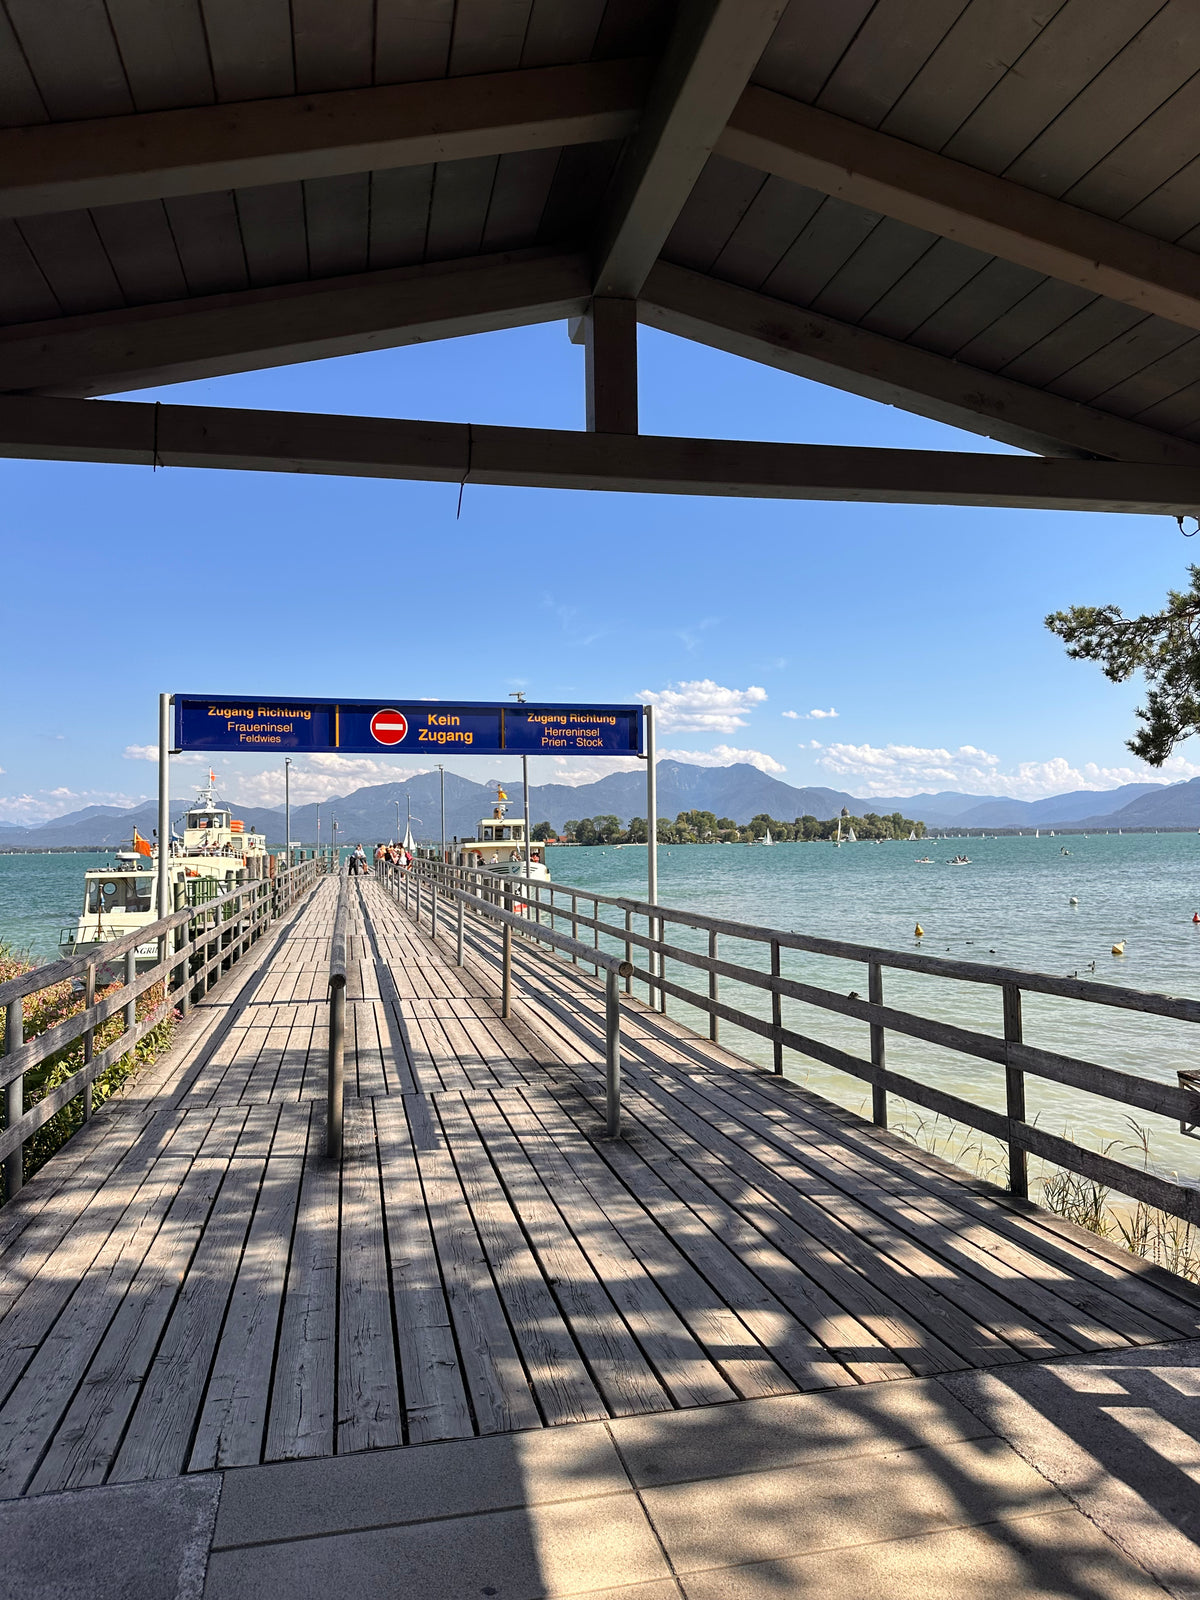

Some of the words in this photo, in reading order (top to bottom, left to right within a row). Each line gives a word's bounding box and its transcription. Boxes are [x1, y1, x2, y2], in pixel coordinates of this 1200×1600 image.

[207, 706, 254, 719] Zugang
[257, 707, 312, 720] Richtung
[527, 713, 567, 725] Zugang
[569, 713, 616, 725] Richtung
[427, 713, 460, 726] Kein
[227, 721, 293, 733] Fraueninsel
[544, 727, 600, 737] Herreninsel
[239, 733, 282, 743] Feldwies
[418, 728, 473, 745] Zugang
[541, 737, 567, 747] Prien
[576, 738, 603, 747] Stock
